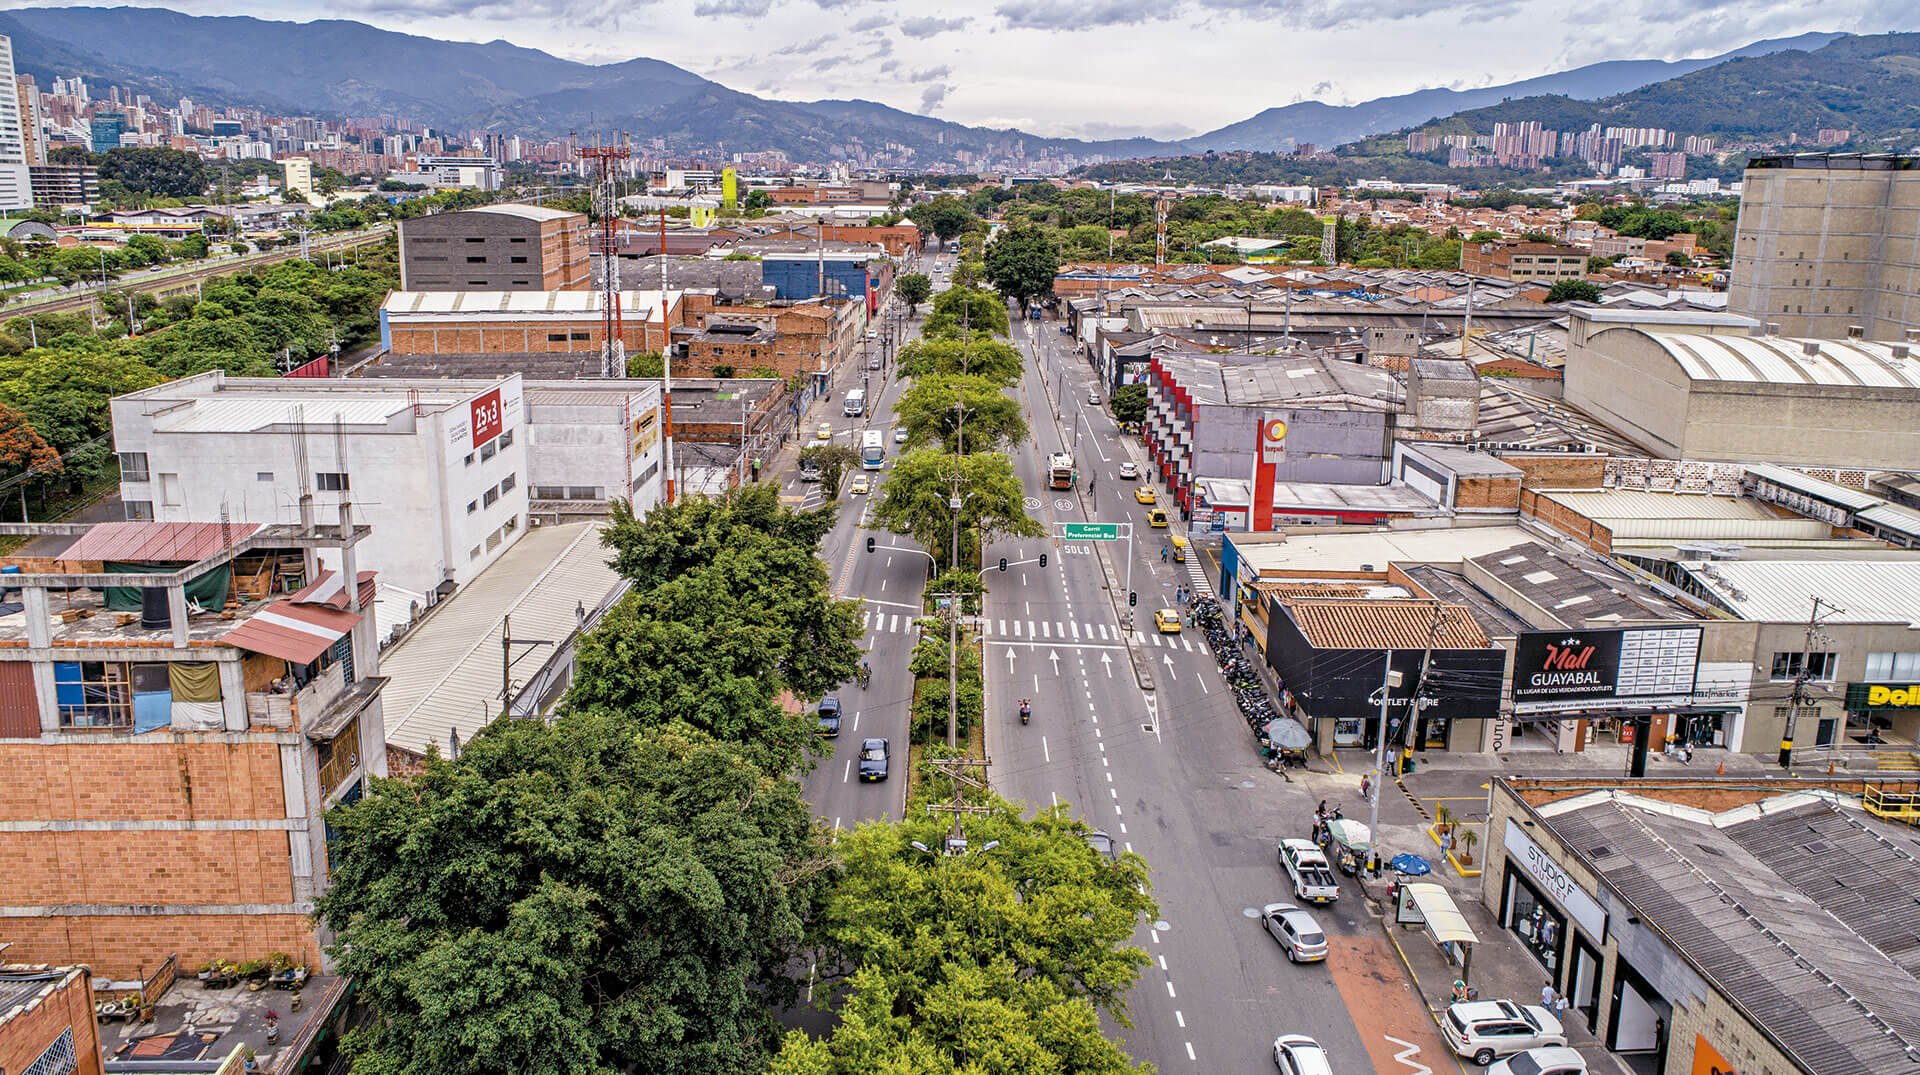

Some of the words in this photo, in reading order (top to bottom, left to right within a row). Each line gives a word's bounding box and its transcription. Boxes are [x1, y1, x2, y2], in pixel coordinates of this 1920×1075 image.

[1064, 545, 1090, 555] SOLO
[1543, 643, 1596, 670] Mall
[1531, 671, 1600, 686] GUAYABAL
[1410, 698, 1439, 706] SRE
[1528, 846, 1566, 890] STUDIO
[1567, 884, 1575, 896] F
[1532, 864, 1567, 903] OUTLET
